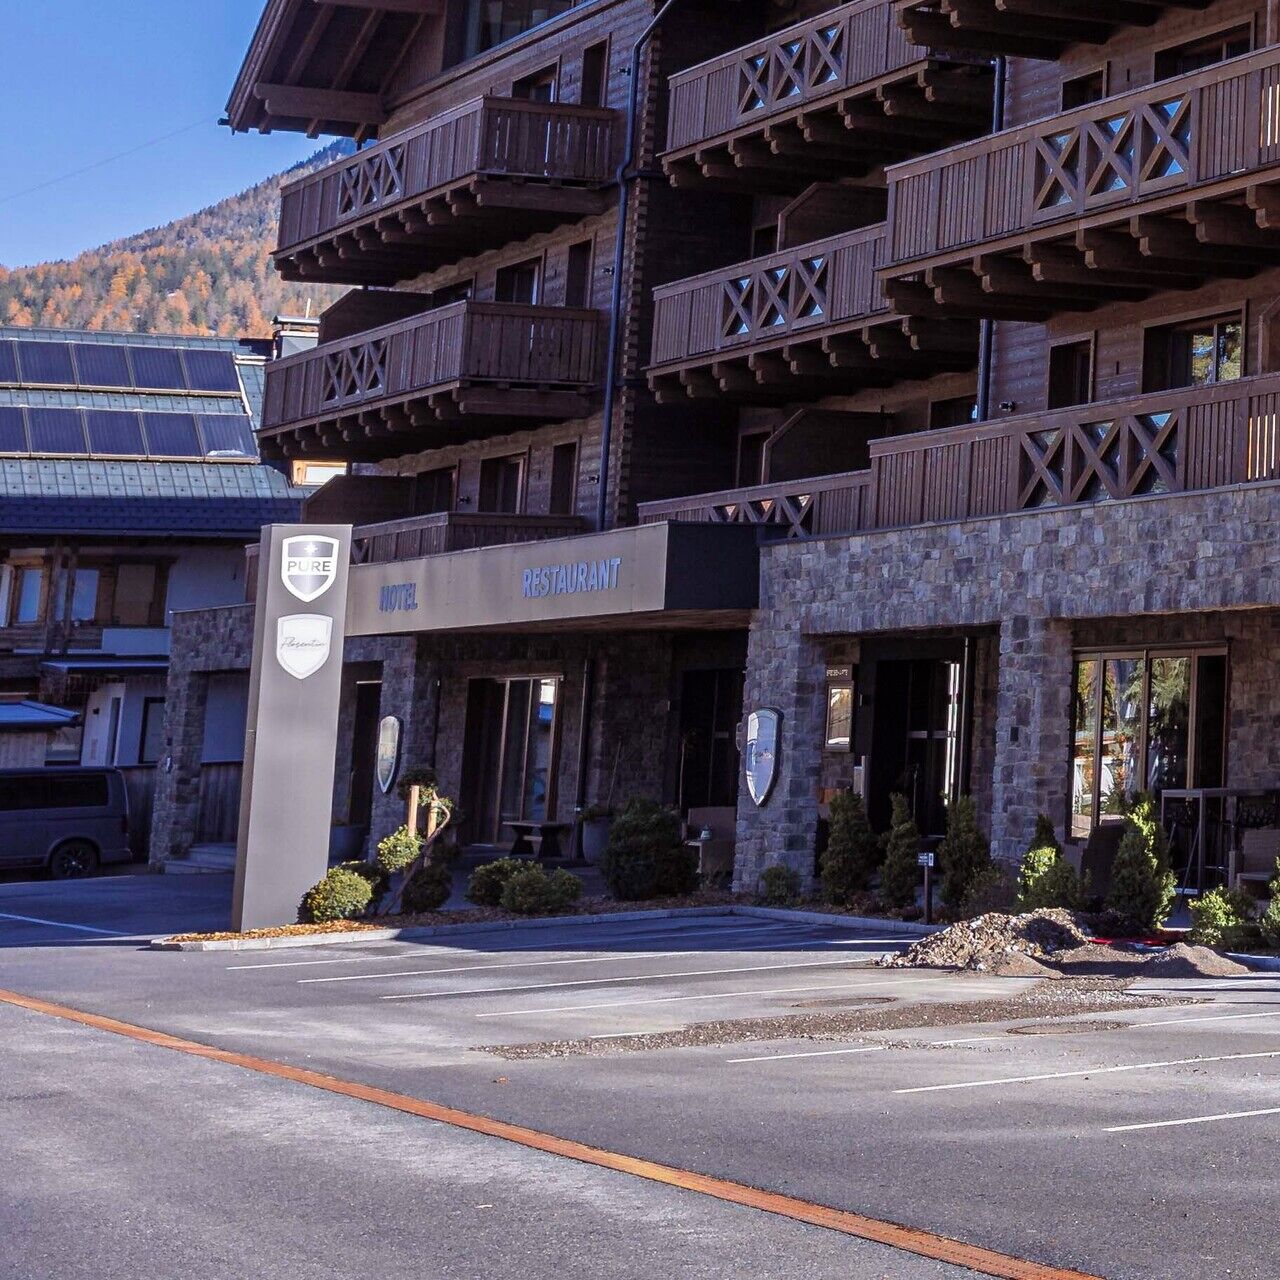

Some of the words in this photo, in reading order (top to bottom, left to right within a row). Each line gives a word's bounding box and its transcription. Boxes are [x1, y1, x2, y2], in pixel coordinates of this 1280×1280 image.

[287, 560, 332, 572] PURE
[379, 583, 418, 612] HOTEL
[522, 558, 621, 598] RESTAURANT
